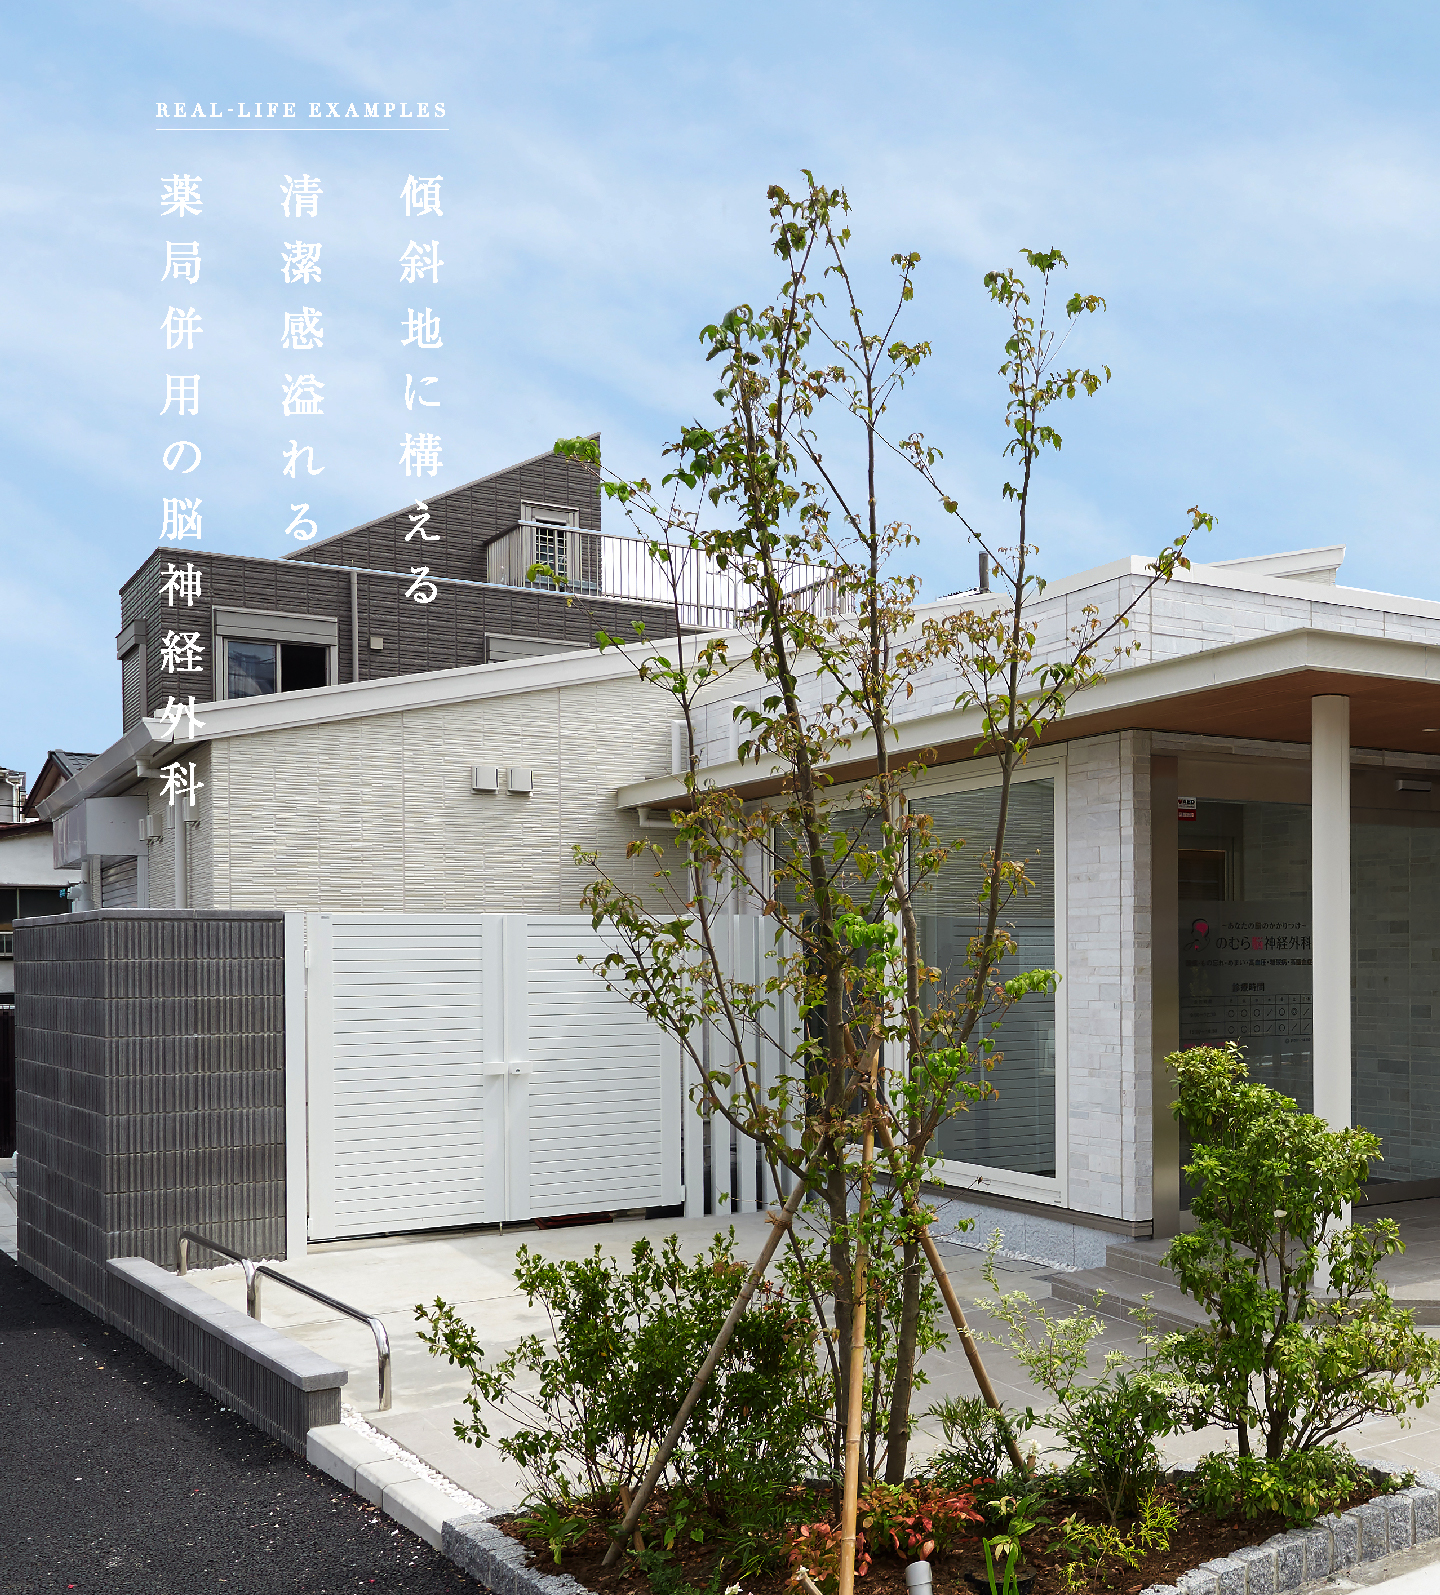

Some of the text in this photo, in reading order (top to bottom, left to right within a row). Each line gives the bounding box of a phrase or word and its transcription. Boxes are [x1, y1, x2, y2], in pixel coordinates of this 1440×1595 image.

[1216, 936, 1311, 950] のむら脳神経外科
